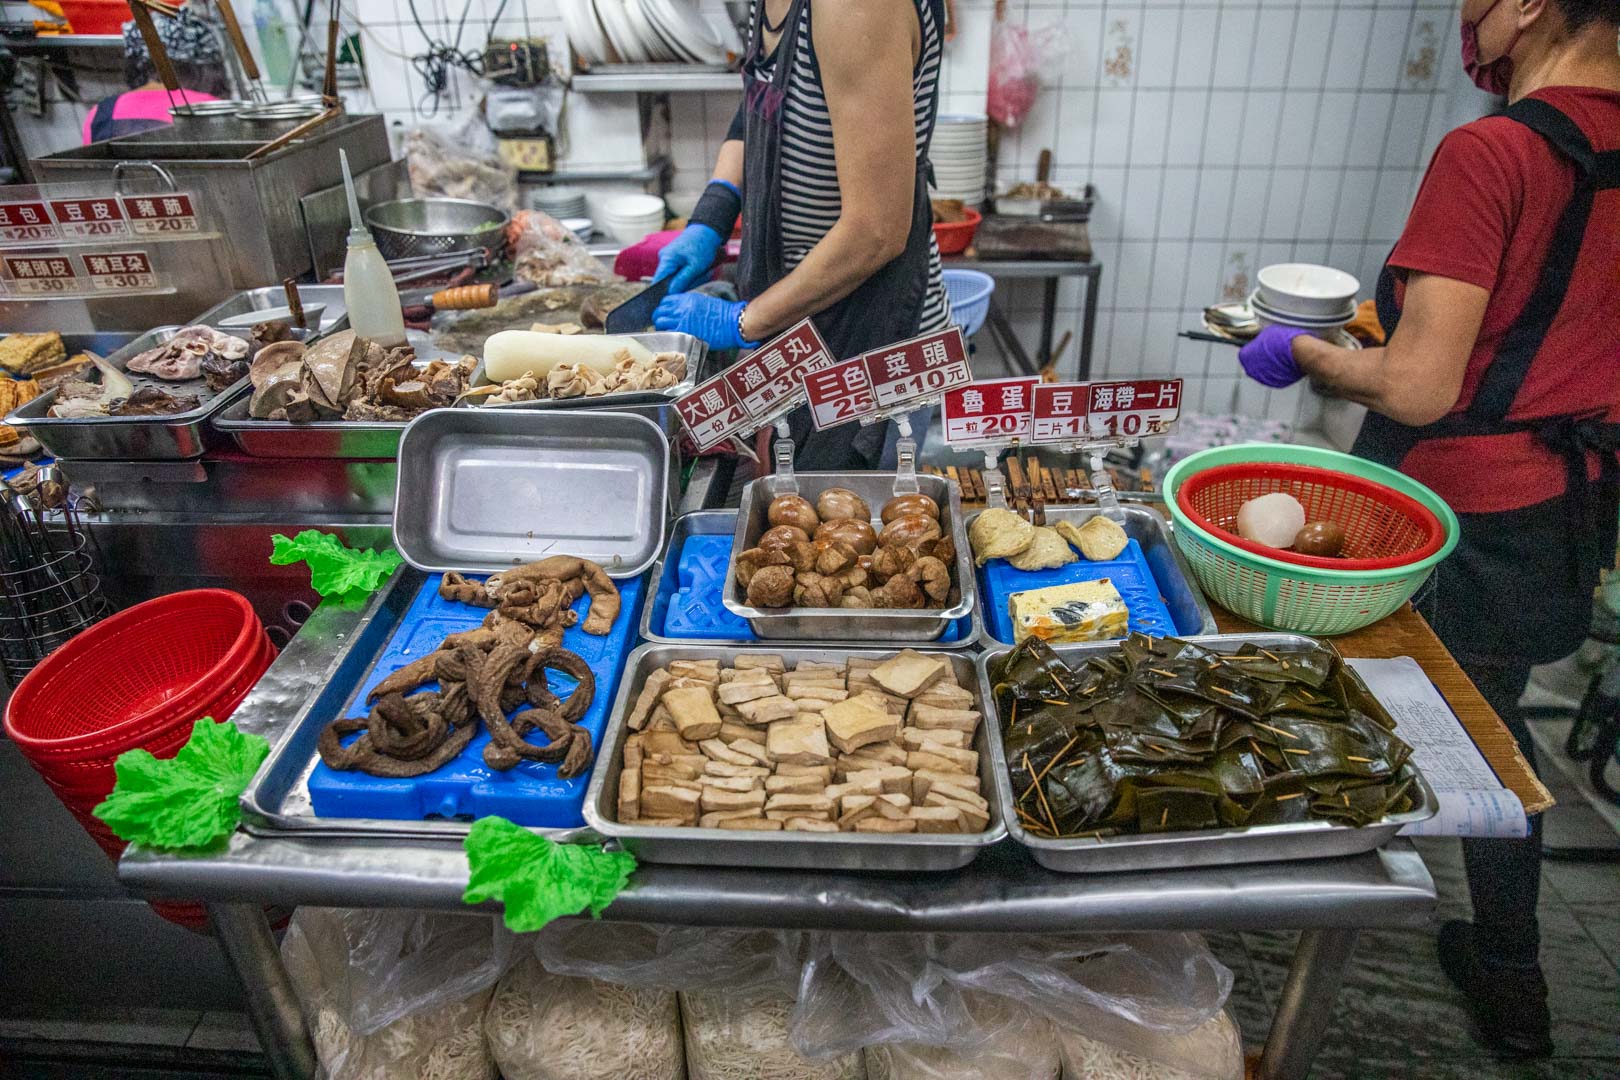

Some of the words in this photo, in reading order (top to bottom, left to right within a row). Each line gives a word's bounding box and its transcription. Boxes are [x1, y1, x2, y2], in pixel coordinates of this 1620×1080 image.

[64, 203, 112, 221] 豆皮
[136, 198, 183, 217] 豬肺
[13, 260, 69, 277] 豬頭皮
[89, 255, 146, 274] 豬耳朵
[736, 336, 813, 392] 滷貢丸
[883, 339, 949, 378] 菜頭
[748, 354, 827, 411] 二顆30元
[816, 366, 869, 399] 三色
[879, 364, 965, 396] 一個10元
[684, 387, 726, 425] 大腸
[832, 391, 874, 419] 25
[962, 385, 1025, 414] 魯蛋
[1050, 391, 1073, 415] 豆
[1093, 384, 1177, 411] 海帶一片
[1037, 418, 1088, 436] 二片1
[1104, 414, 1161, 437] 10元
